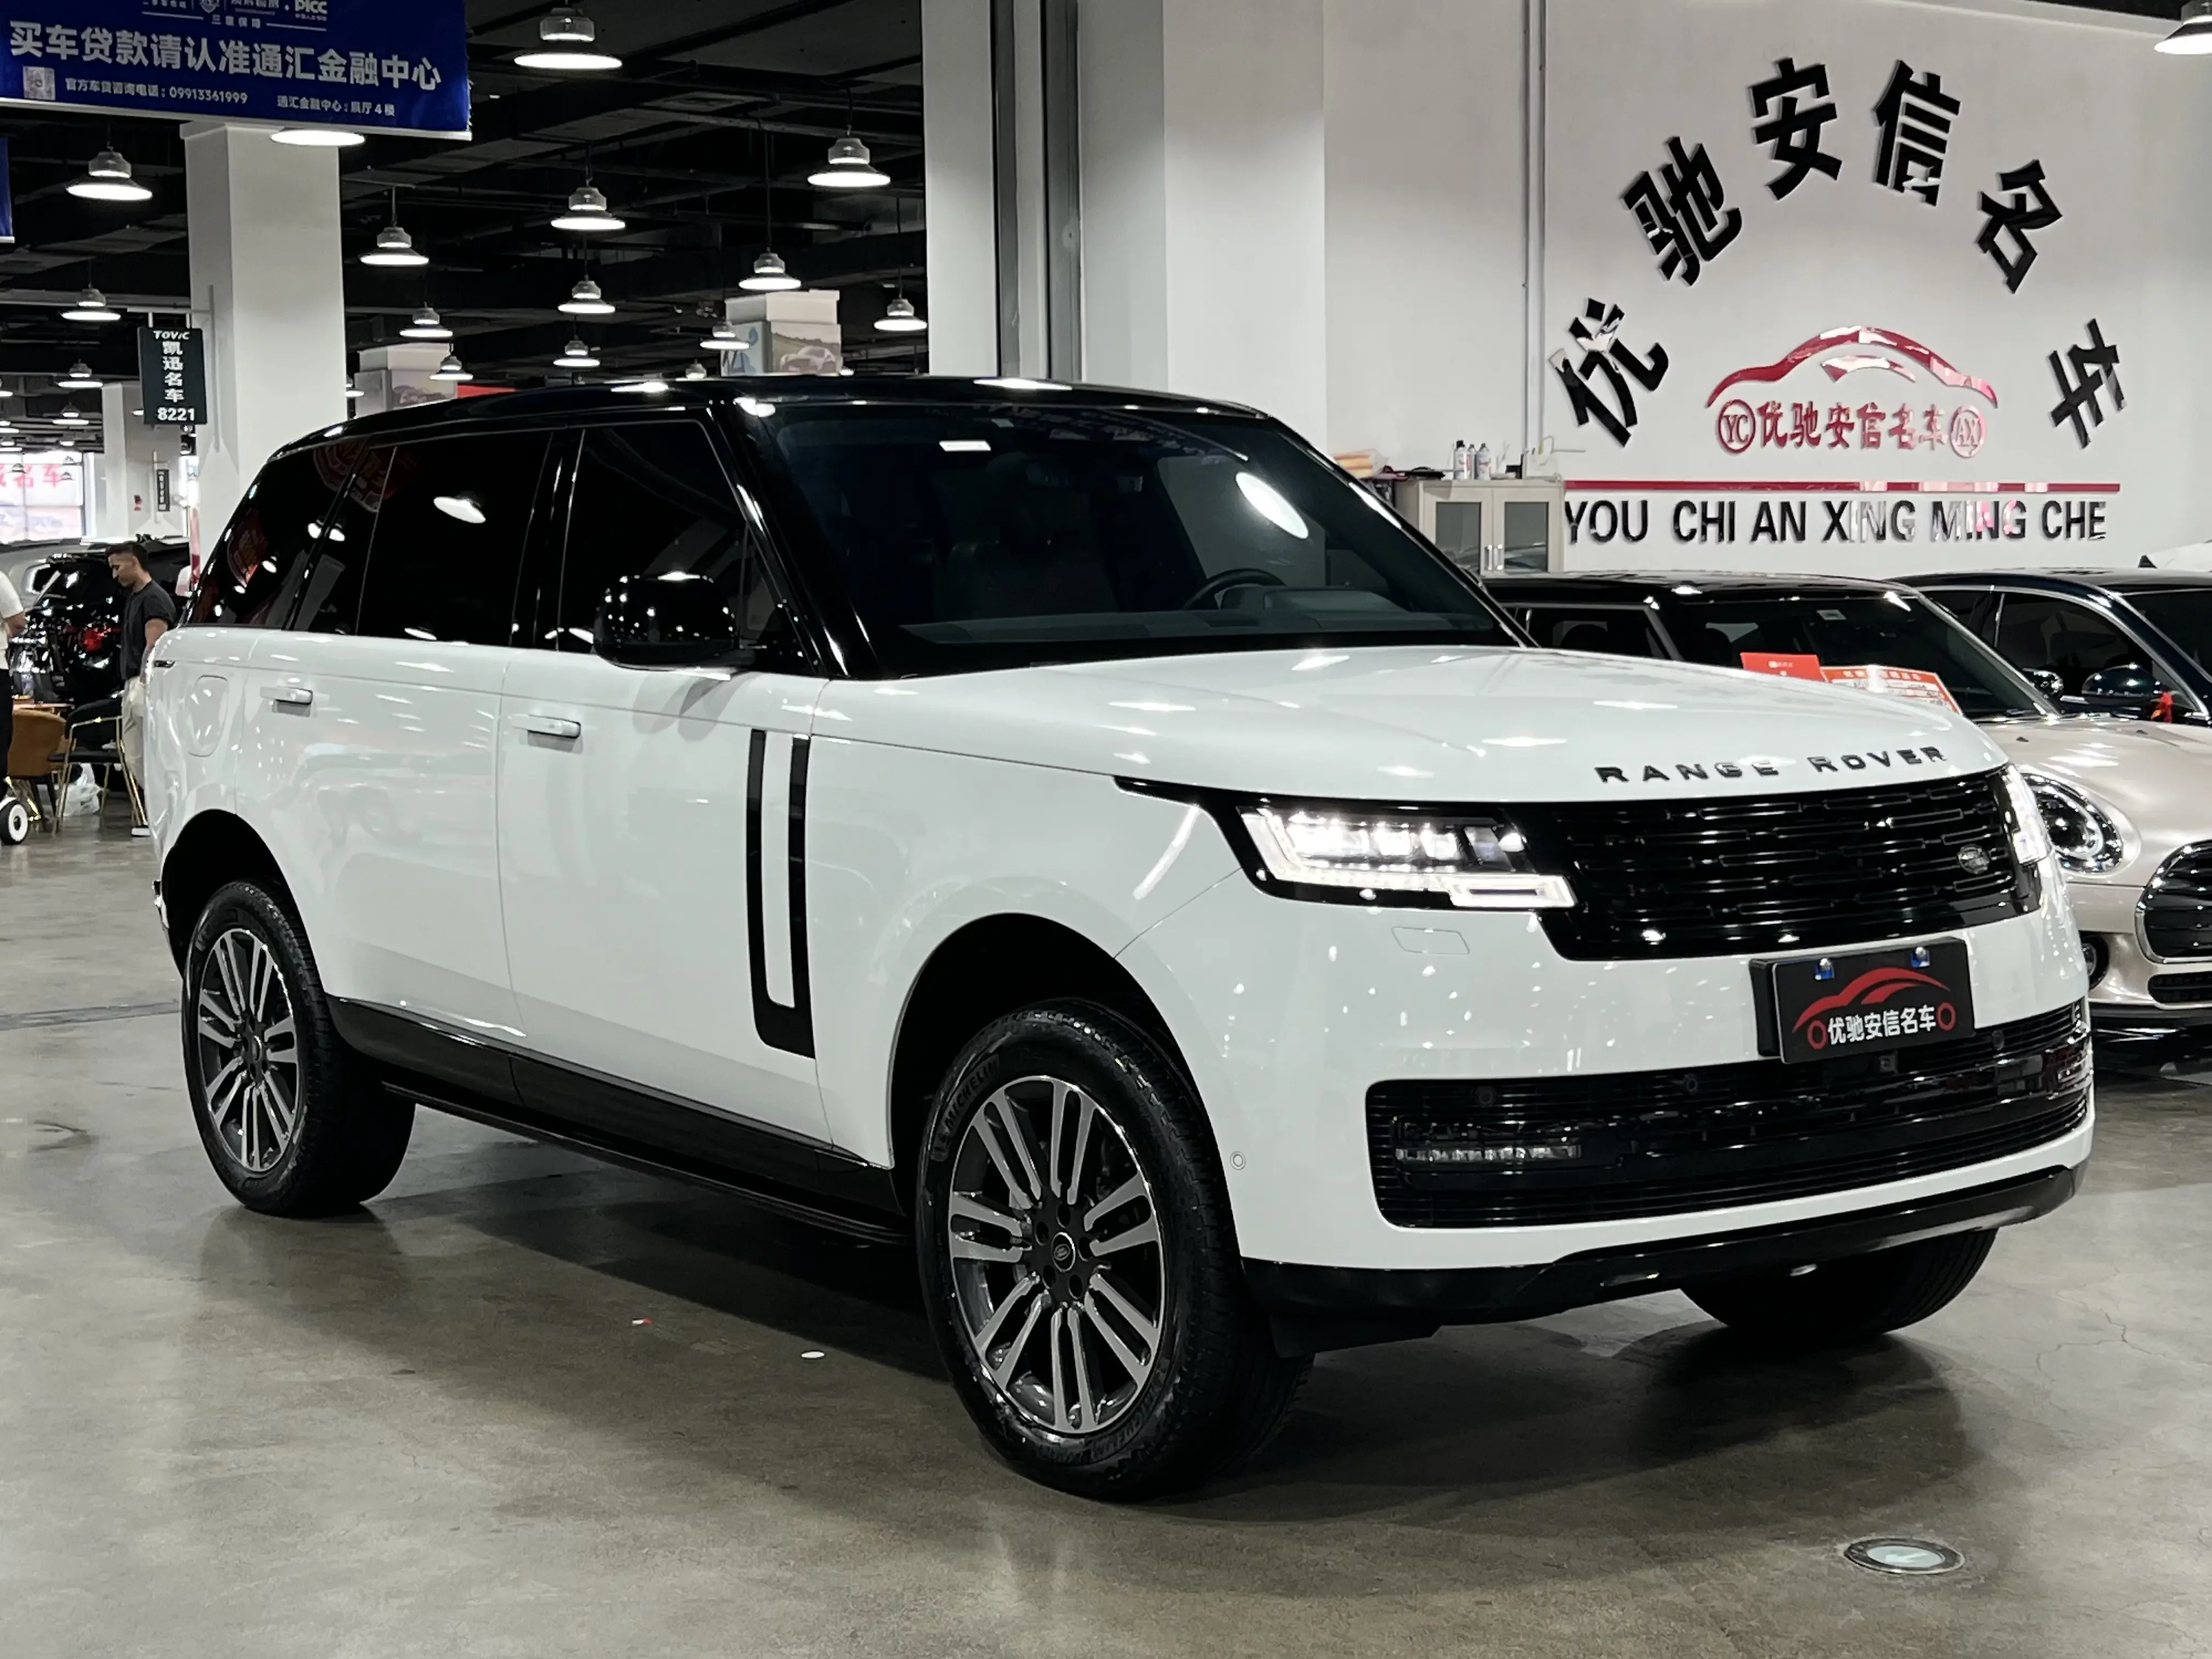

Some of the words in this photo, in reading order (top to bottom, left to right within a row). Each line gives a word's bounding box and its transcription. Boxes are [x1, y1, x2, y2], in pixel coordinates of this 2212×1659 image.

[9, 20, 442, 91] 买车贷款请认准通汇金融中心
[1549, 57, 2127, 449] 优驰安信名车
[157, 407, 195, 421] 8221
[1757, 400, 1948, 450] 优驰安信名车
[1564, 500, 1647, 543] YOU
[1672, 500, 1736, 543] CHI
[1751, 500, 1808, 543] AN
[1821, 500, 1917, 543] XING
[1930, 500, 2027, 543] MING
[2040, 500, 2107, 543] CHE
[1594, 760, 1779, 783] RANGE
[1807, 746, 1946, 773] ROVER
[1827, 1003, 1937, 1046] 优驰安信名车
